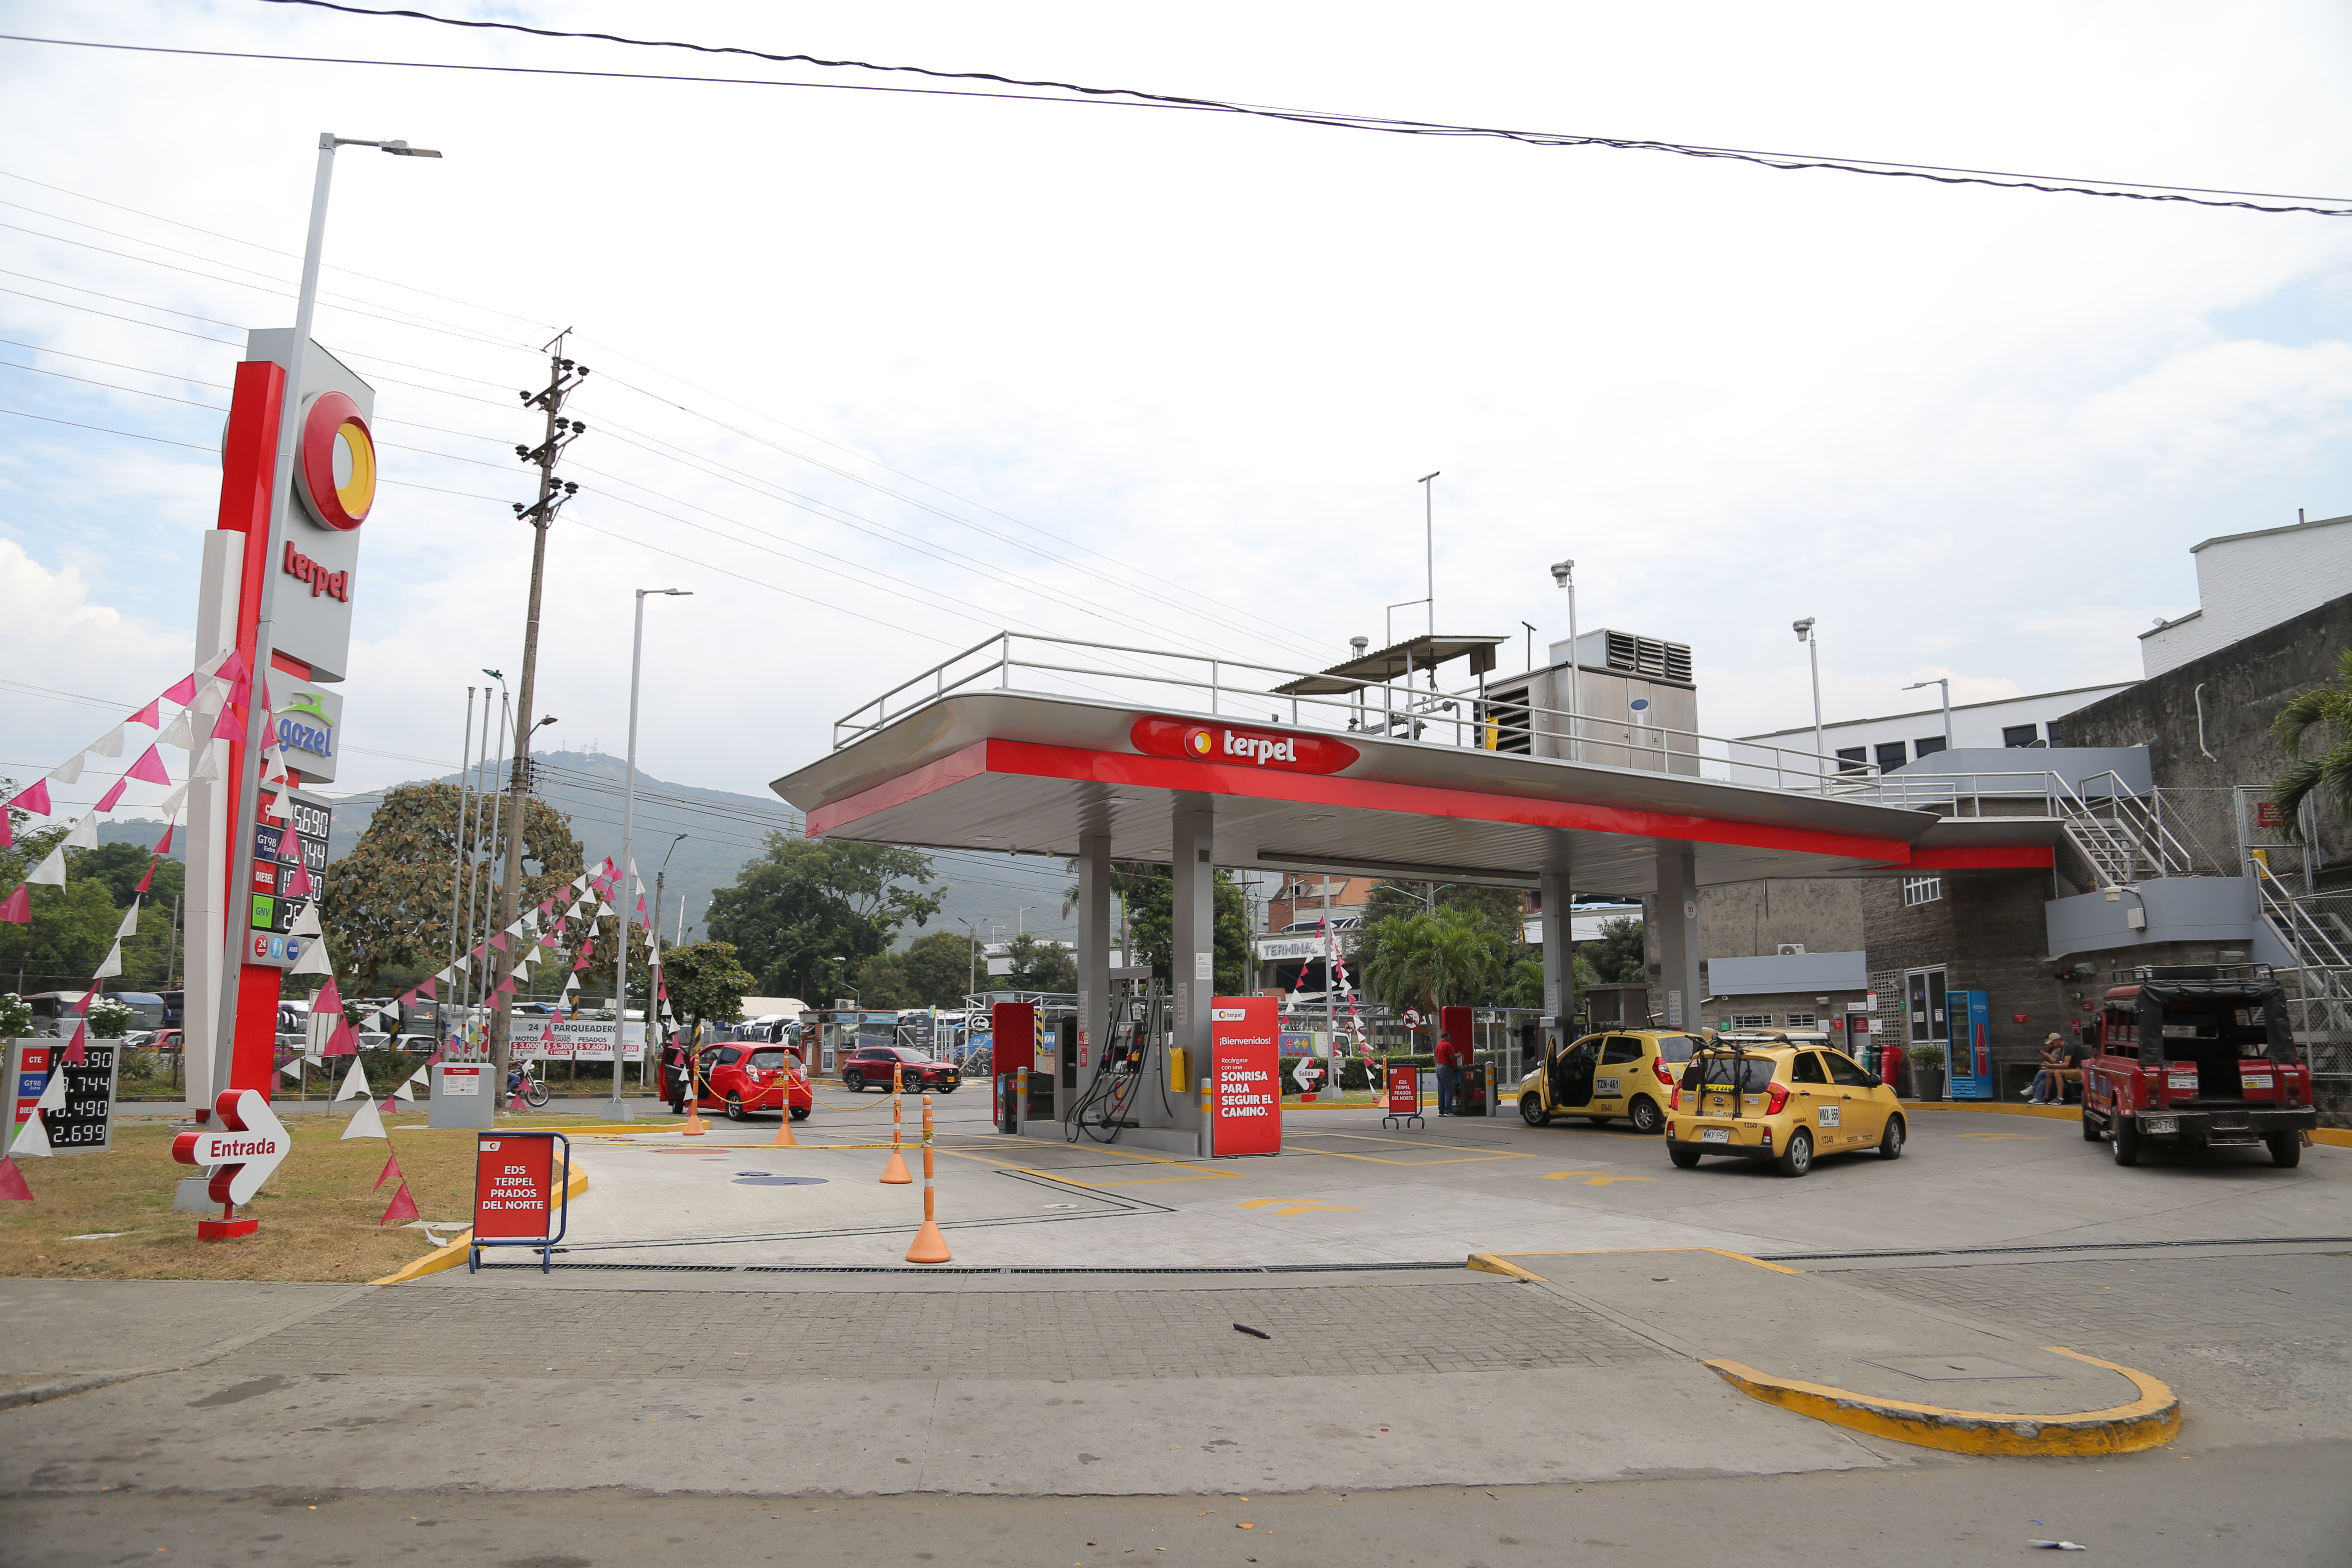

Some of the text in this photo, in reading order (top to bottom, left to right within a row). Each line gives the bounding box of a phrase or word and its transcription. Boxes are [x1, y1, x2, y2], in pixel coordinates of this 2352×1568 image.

[283, 540, 349, 603] terpel
[278, 718, 332, 757] gazel
[1223, 730, 1297, 765] terpel
[258, 834, 276, 847] GT98
[256, 871, 274, 884] DIESEL
[256, 907, 270, 917] GNV
[258, 939, 266, 948] 24
[1227, 1012, 1243, 1020] terpel
[1219, 1036, 1271, 1046] ¡Bienvenidos!
[1221, 1071, 1268, 1082] SONRISA
[1221, 1083, 1250, 1094] PARA
[1221, 1094, 1273, 1105] SEGUIR EL
[1221, 1106, 1268, 1117] CAMINO.
[54, 1125, 105, 1143] 2.699
[1822, 1136, 1834, 1144] 13349
[211, 1138, 276, 1158] Entrada
[504, 1165, 526, 1174] EDS
[494, 1177, 535, 1186] TERPEL
[490, 1189, 537, 1198] PRADOS
[482, 1200, 544, 1210] DEL NORTE
